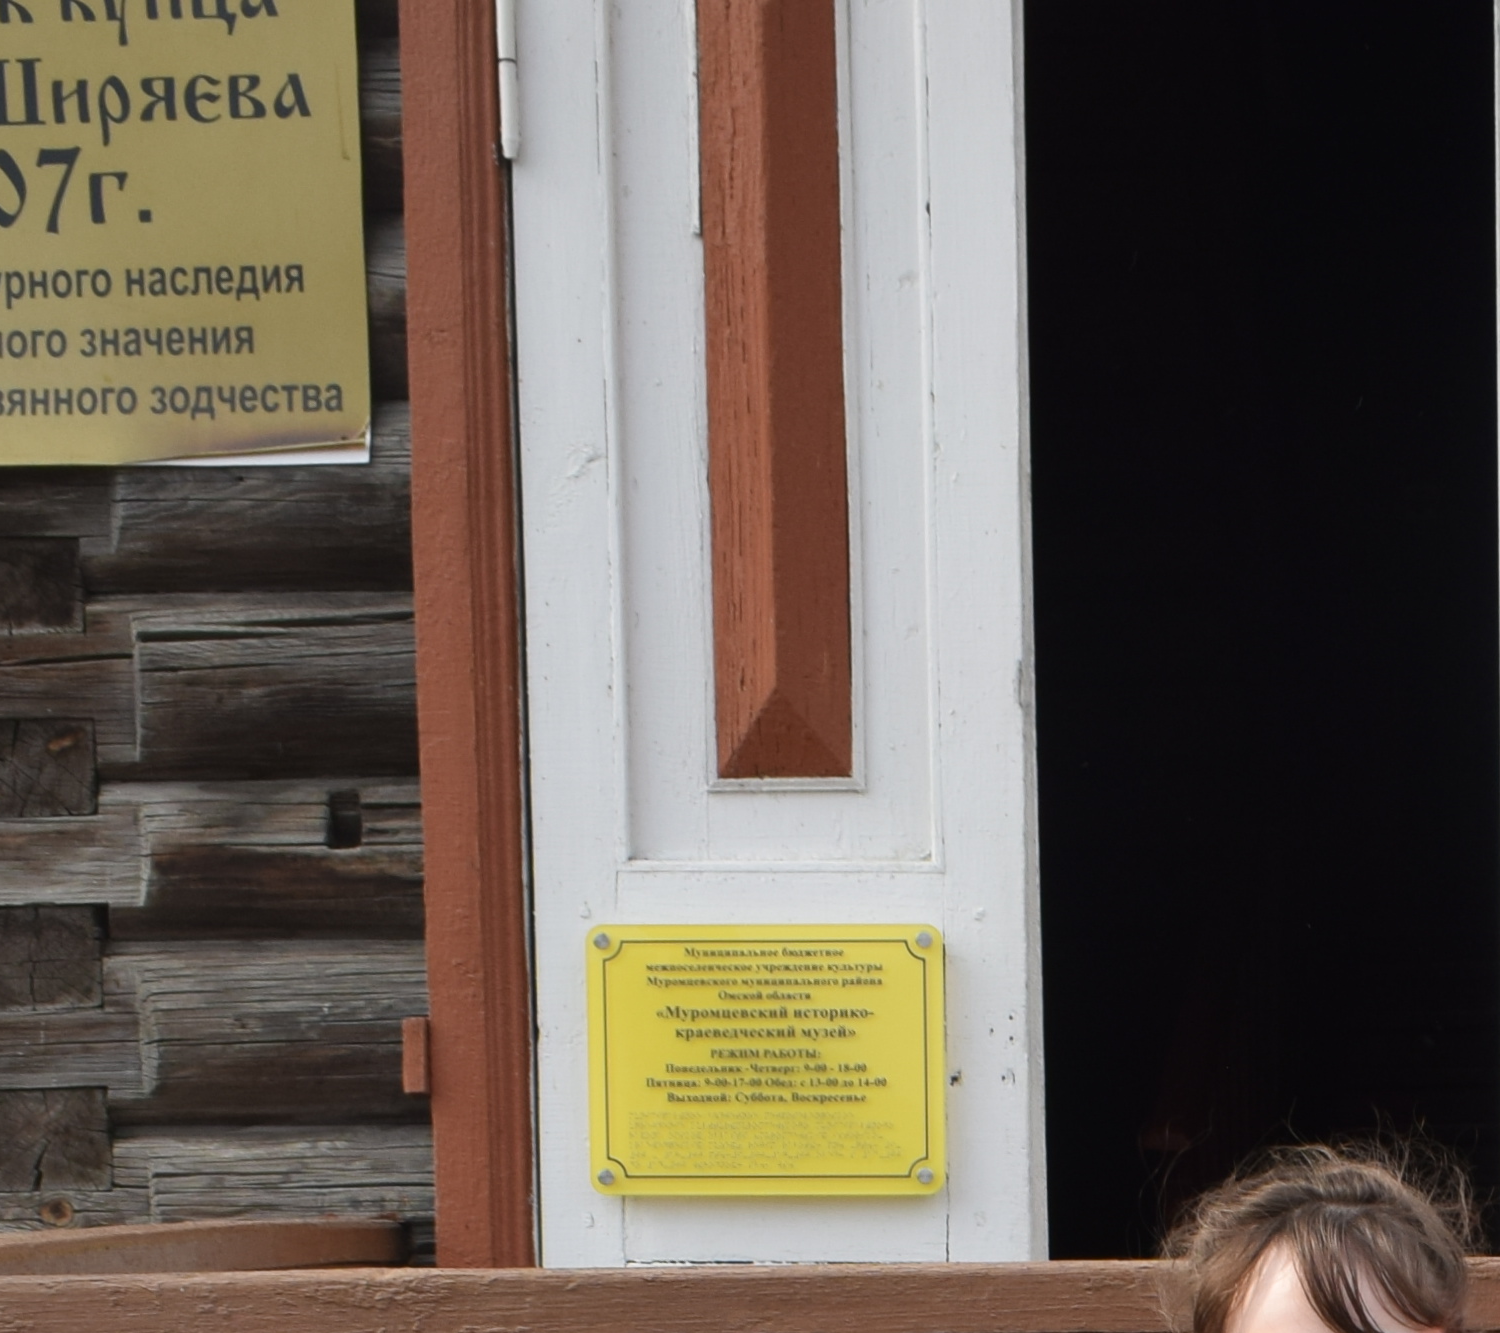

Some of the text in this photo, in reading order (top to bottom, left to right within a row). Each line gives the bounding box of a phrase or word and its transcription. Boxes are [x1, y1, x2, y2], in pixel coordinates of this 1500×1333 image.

[125, 264, 305, 301] наследия
[79, 325, 255, 358] значения
[150, 383, 344, 420] зодчества
[684, 947, 844, 959] Муниципальное бюджетное
[646, 963, 884, 974] межпоселенческое учреждение культуры
[647, 976, 883, 988] Муромцевского муниципального района
[718, 990, 811, 1001] Омской области
[656, 1005, 875, 1022] «Муромцевский историко-
[675, 1025, 857, 1042] краеведческий музей»
[710, 1048, 822, 1059] РЕЖИМ РАБОТЫ:
[665, 1063, 742, 1074] Понедельник
[838, 1063, 867, 1073] 18-00
[646, 1077, 701, 1088] Пятница:
[858, 1077, 887, 1087] 14-00
[667, 1091, 731, 1102] Выходной:
[791, 1091, 867, 1104] Воскресенье
